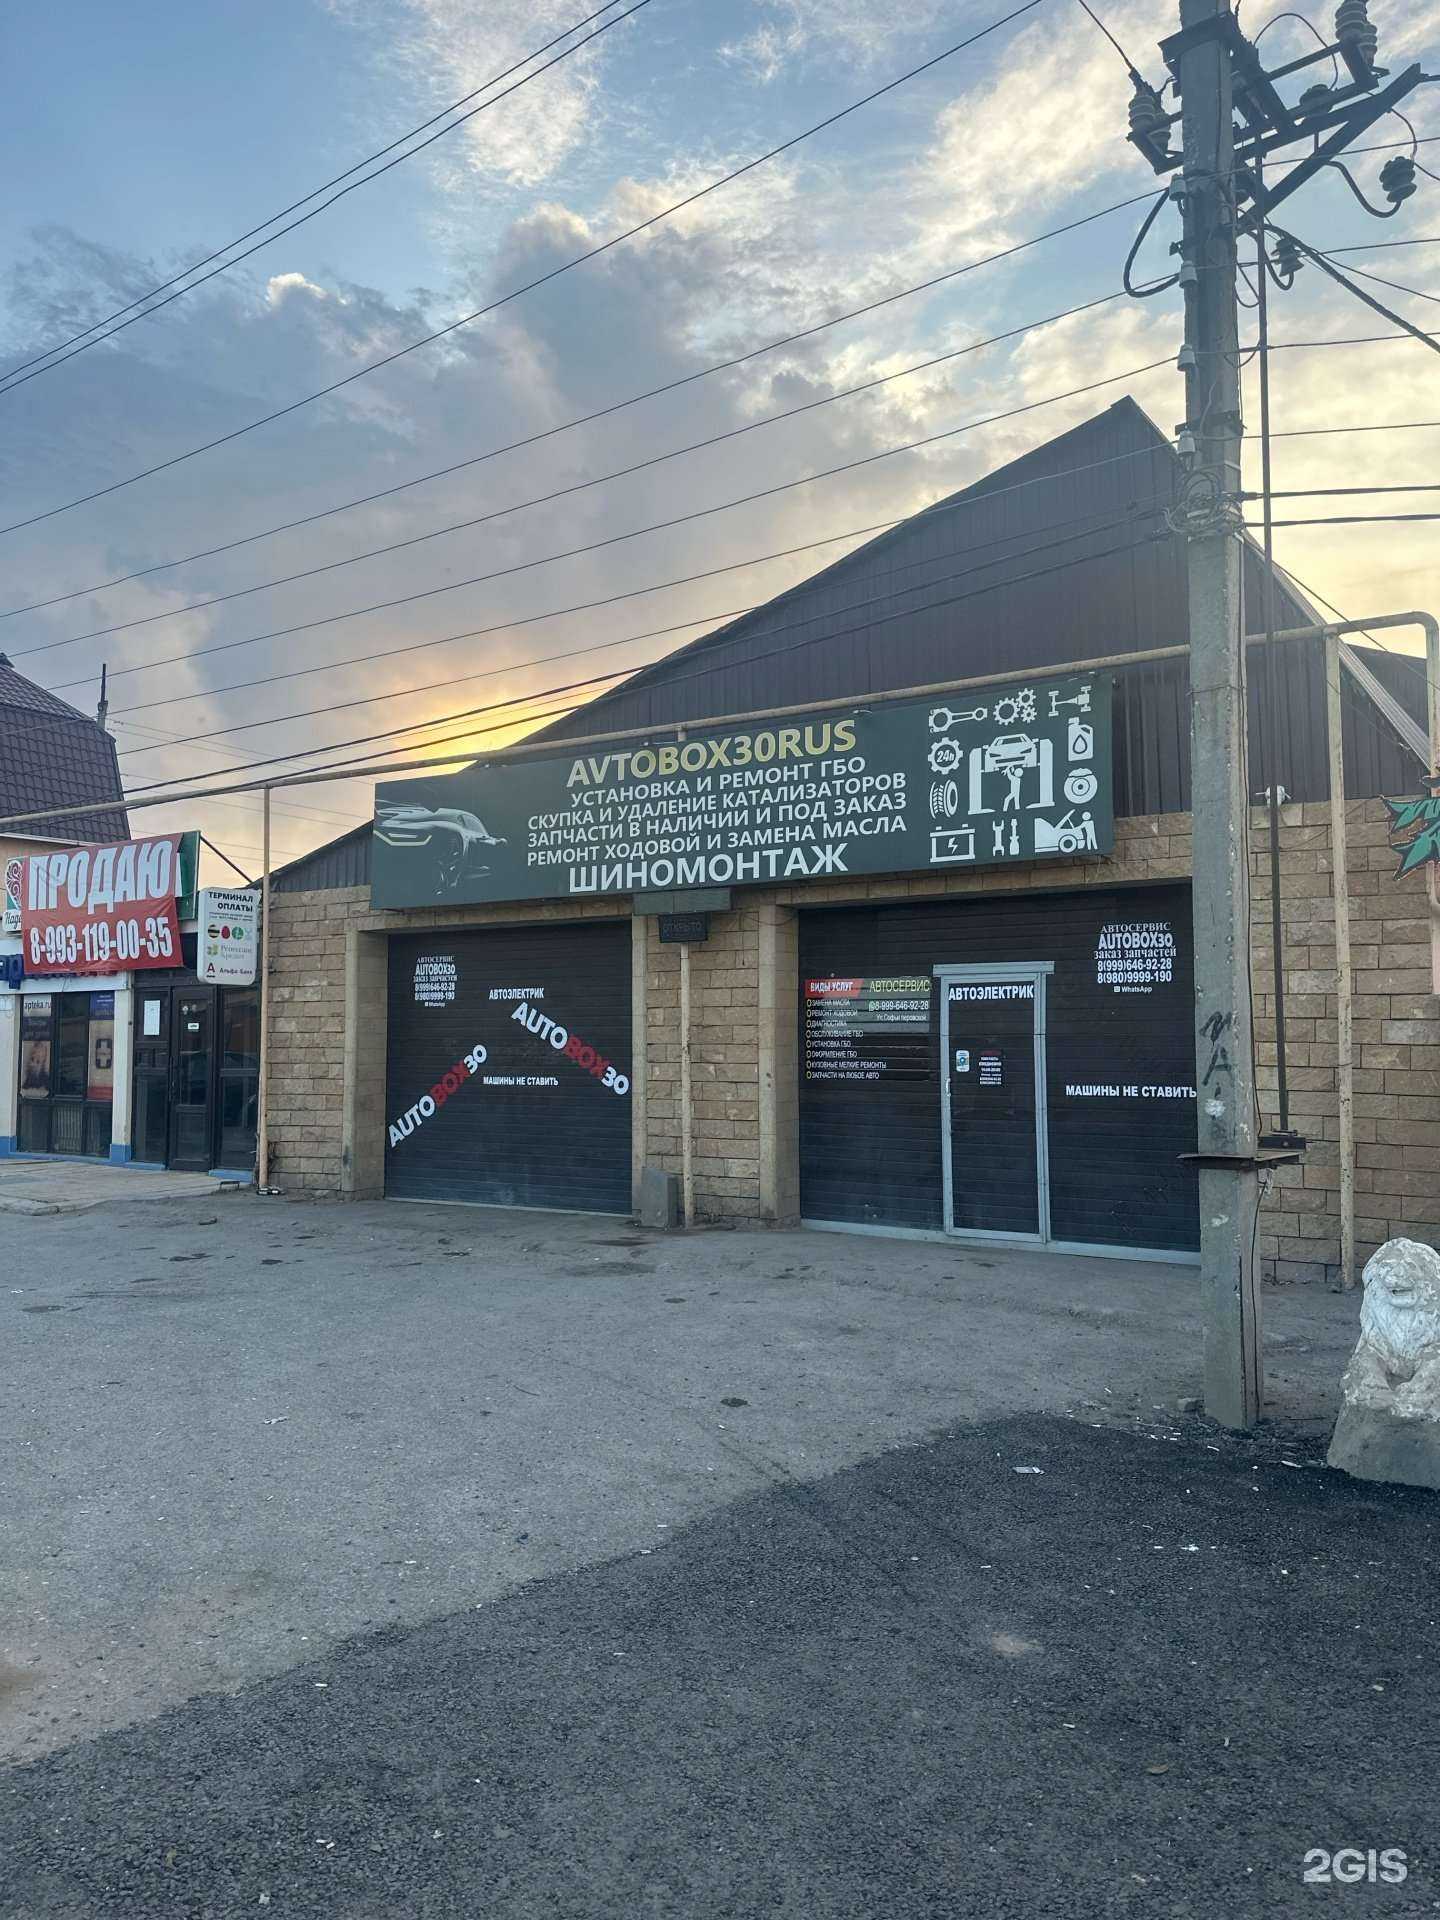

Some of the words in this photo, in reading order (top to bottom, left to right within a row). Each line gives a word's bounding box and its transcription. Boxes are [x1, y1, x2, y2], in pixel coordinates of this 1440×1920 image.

[566, 720, 856, 787] AVTOBOX30RUS
[571, 779, 690, 807] УСТАНОВКА
[697, 776, 712, 792] И
[720, 763, 813, 790] РЕМОНТ
[821, 757, 866, 777] ГБО
[528, 810, 594, 830] СКУПКА
[600, 808, 612, 822] И
[618, 795, 717, 822] УДАЛЕНИЕ
[723, 773, 906, 808] КАТАЛИЗАТОРОВ
[528, 823, 623, 848] ЗАПЧАСТИ
[630, 822, 640, 837] В
[647, 809, 749, 836] НАЛИЧИИ
[757, 807, 770, 824] И
[779, 801, 827, 823] ПОД
[834, 792, 907, 816] ЗАКАЗ
[528, 846, 600, 866] РЕМОНТ
[604, 833, 700, 860] ХОДОВОЙ
[708, 833, 721, 850] И
[727, 825, 816, 848] ЗАМЕНА
[823, 815, 907, 839] МАСЛА
[569, 843, 849, 893] ШИНОМОНТАЖ
[28, 840, 173, 915] ПРОДАЮ
[208, 891, 254, 902] ТЕРМИНАЛ
[217, 902, 253, 912] ОПЛАТЫ
[1101, 922, 1172, 933] АВТОСЕРВИС
[30, 916, 173, 965] 8-993-119-00-35
[1098, 931, 1173, 949] AUTOBOX30
[1093, 950, 1121, 959] заказ
[1124, 945, 1177, 957] запчастей
[1097, 958, 1172, 971] 8(999)646-92-28
[1097, 970, 1172, 983] 8(980)9999-190
[870, 979, 930, 992] АВТОСЕРВИС
[1121, 985, 1152, 994] WhatsApp
[488, 987, 545, 1000] АВТОЭЛЕКТРИК
[949, 985, 1035, 1001] АВТОЭЛЕКТРИК
[875, 1000, 929, 1010] 8-999-646-92-28
[483, 1076, 515, 1085] МАШИНЫ
[516, 1077, 526, 1085] НЕ
[526, 1077, 559, 1086] СТАВИТЬ
[1066, 1084, 1120, 1097] МАШИНЫ
[1122, 1085, 1139, 1098] НЕ
[1141, 1086, 1197, 1099] СТАВИТЬ
